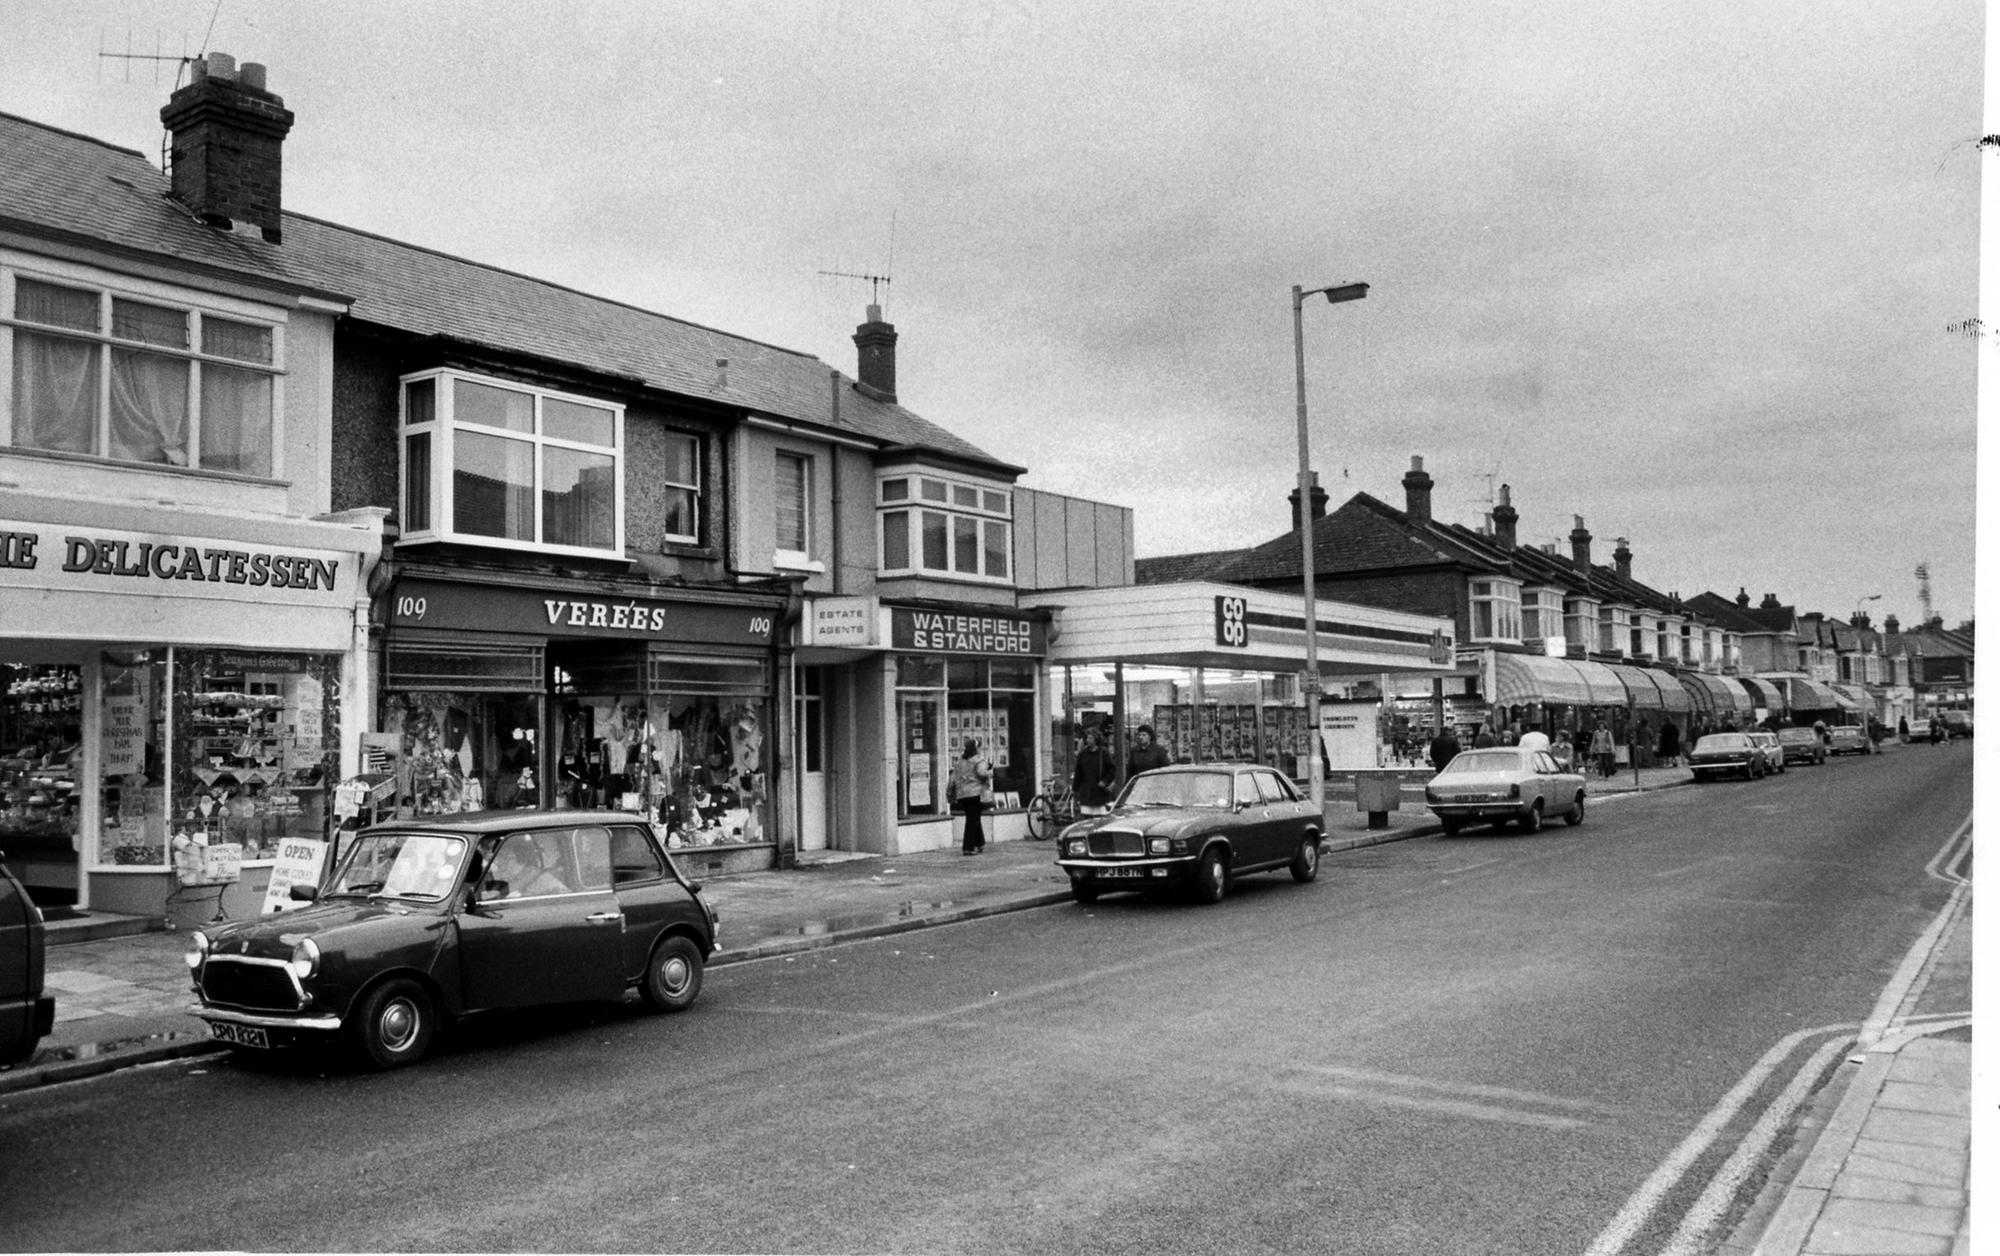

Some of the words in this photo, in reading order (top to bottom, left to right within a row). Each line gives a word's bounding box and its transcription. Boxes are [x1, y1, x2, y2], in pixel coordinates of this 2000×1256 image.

[62, 536, 338, 591] DELICATESSEN
[397, 596, 426, 620] 109
[819, 610, 863, 619] ESTATE
[749, 617, 770, 637] 109
[819, 626, 864, 634] AGENTS
[912, 612, 1030, 636] WATERFIELD
[914, 630, 928, 648] &
[932, 632, 1030, 652] STANFORD
[285, 845, 315, 860] OPEN
[212, 1023, 236, 1040] CPO
